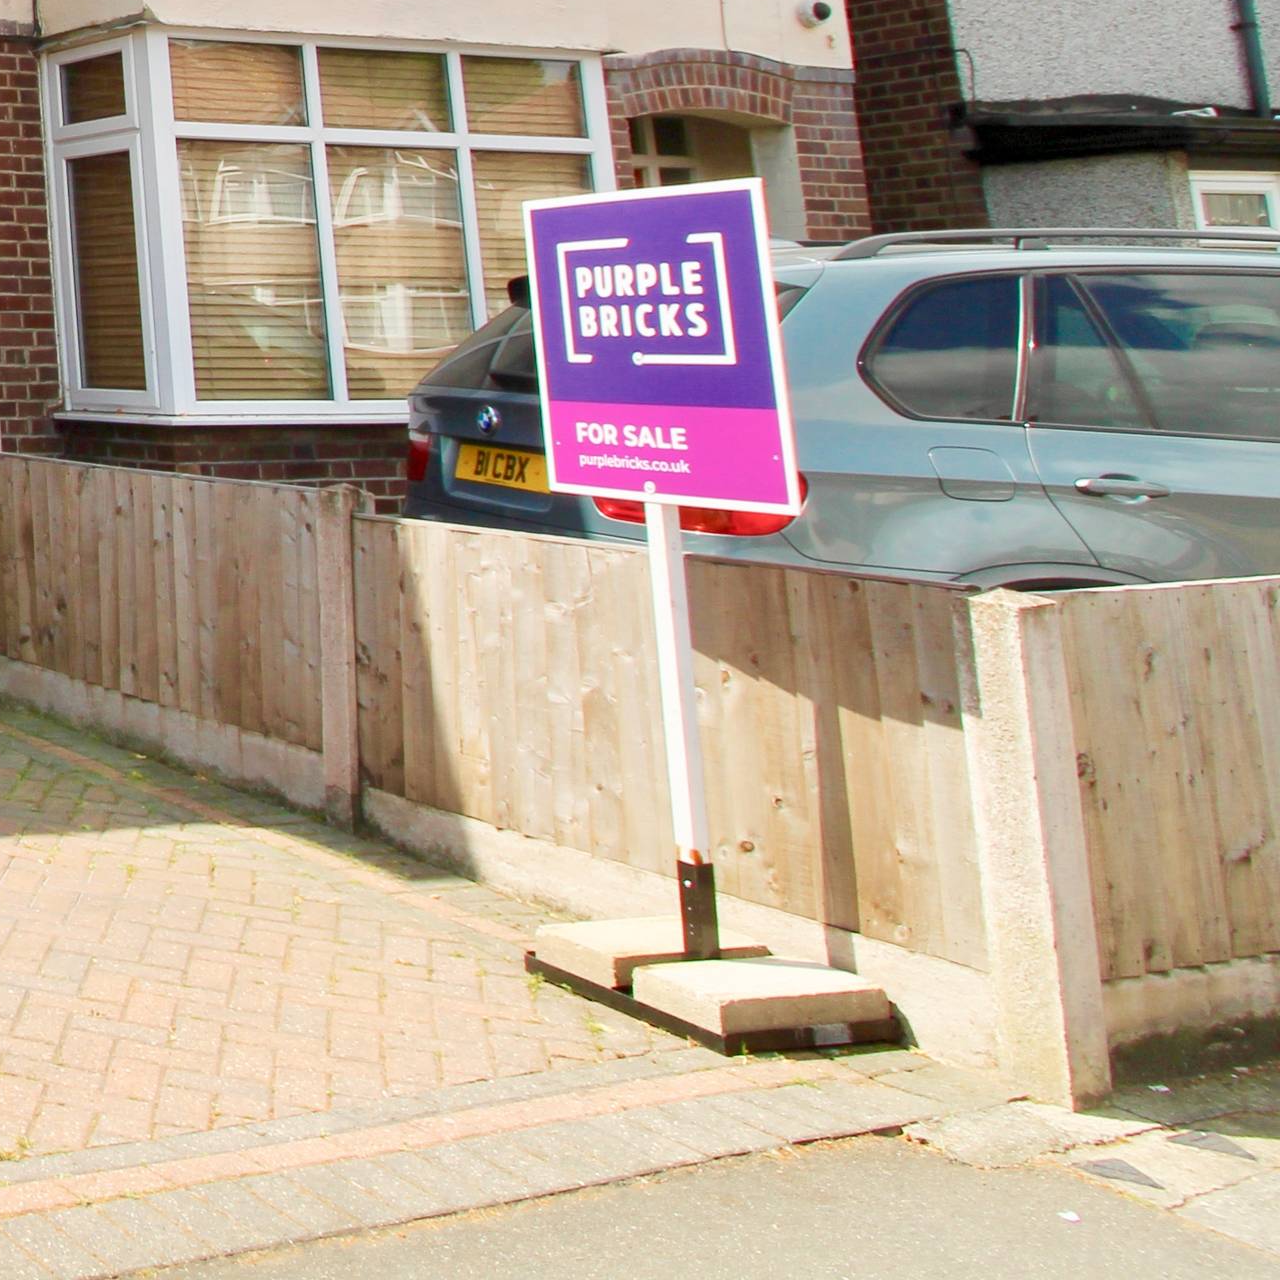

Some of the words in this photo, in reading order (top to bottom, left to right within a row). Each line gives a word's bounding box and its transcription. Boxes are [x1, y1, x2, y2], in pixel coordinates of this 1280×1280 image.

[574, 261, 705, 299] PURPLE
[578, 302, 709, 338] BRICKS
[575, 422, 618, 447] FOR
[623, 424, 689, 451] SALE
[492, 453, 530, 483] CBX
[579, 454, 690, 473] purplebricks.co.uk
